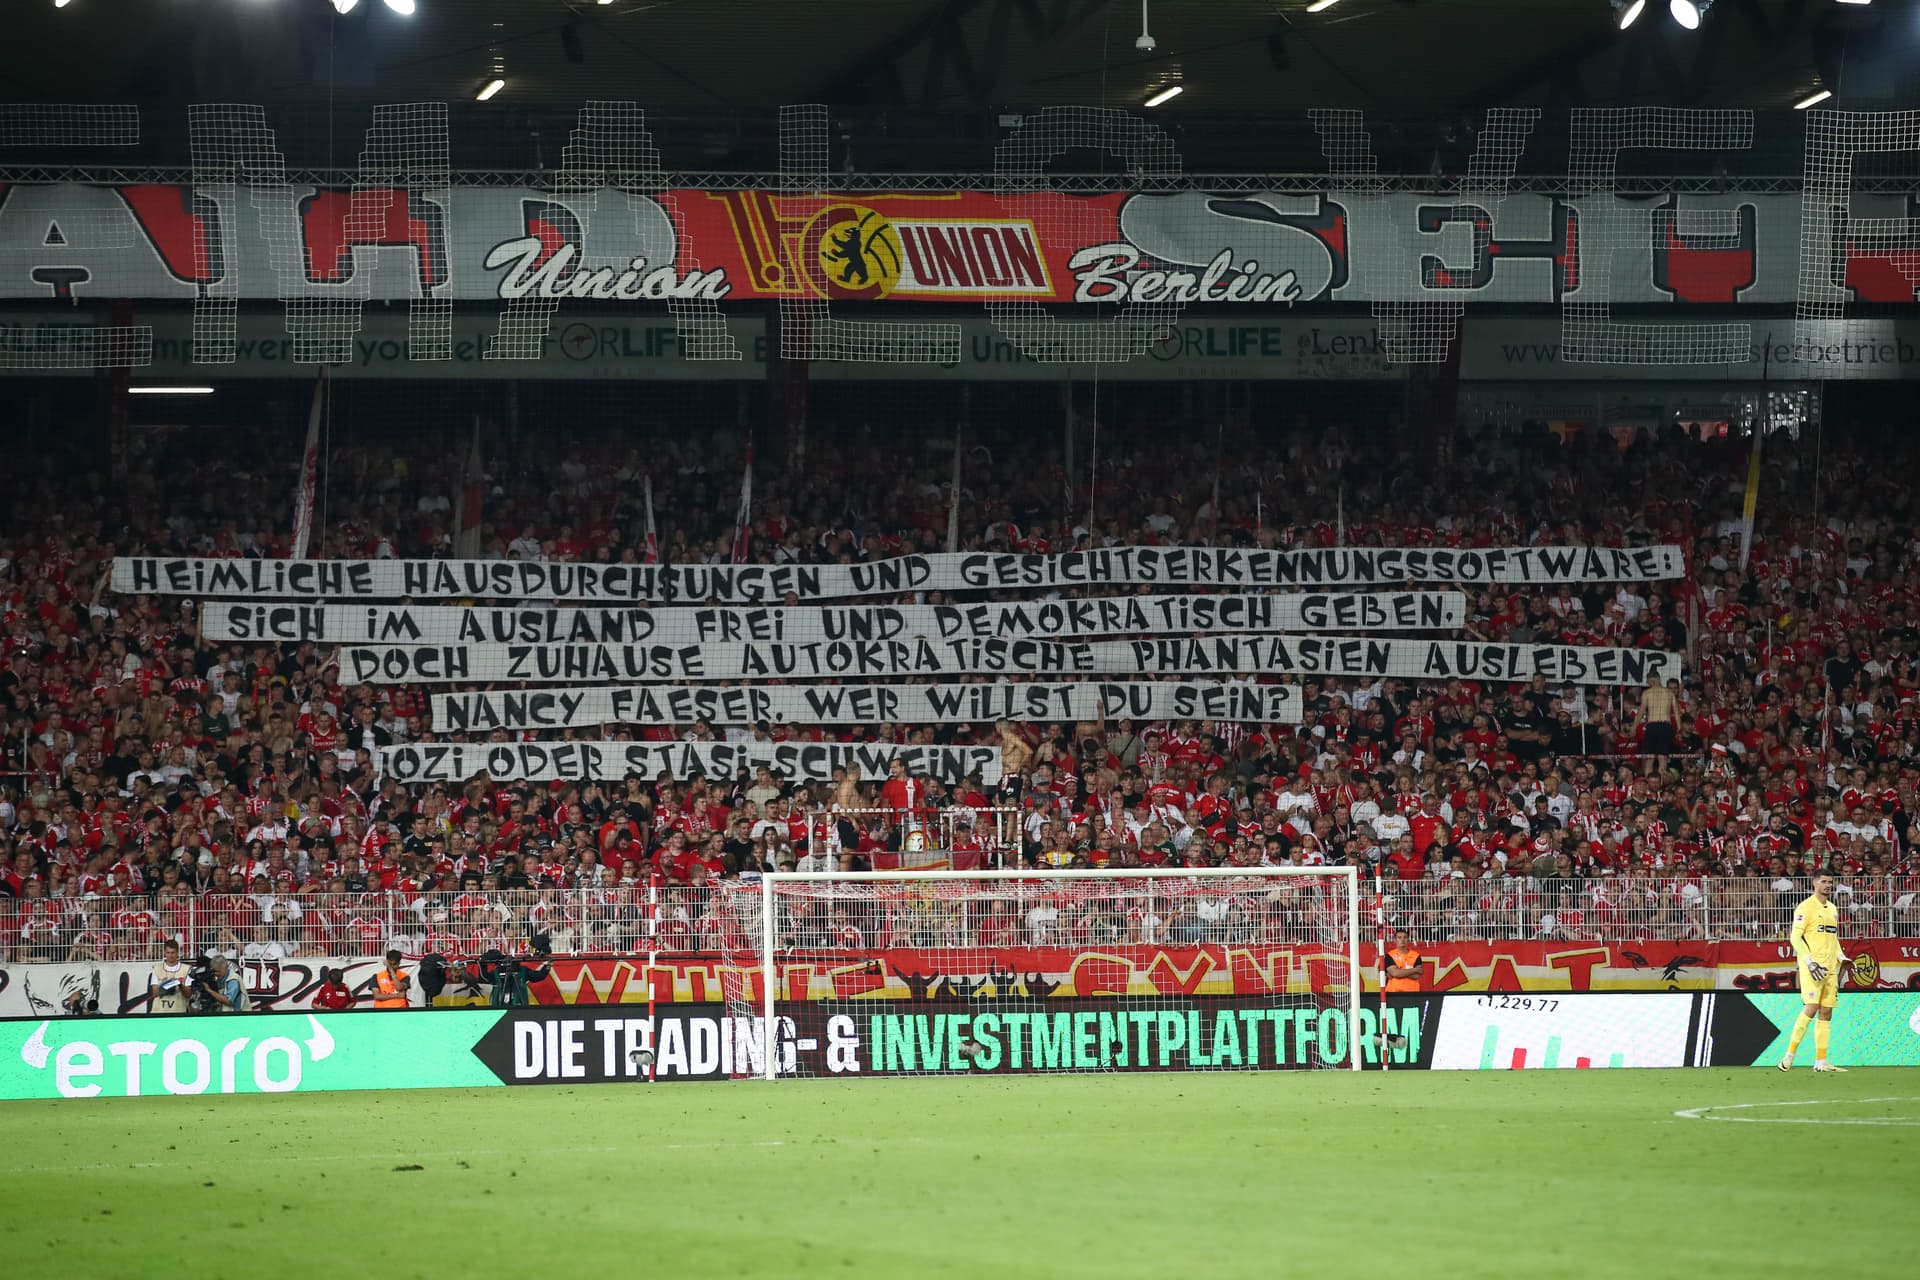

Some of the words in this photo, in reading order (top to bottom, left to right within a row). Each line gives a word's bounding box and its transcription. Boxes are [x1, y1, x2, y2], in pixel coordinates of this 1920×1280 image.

[484, 237, 731, 299] Union
[1068, 242, 1302, 300] Berlin
[902, 226, 1047, 288] UNION
[404, 562, 820, 599] HAUSDURCHSUNGEN
[850, 555, 931, 592] UND
[458, 607, 655, 643] AUSLAND
[822, 608, 904, 642] UND
[352, 646, 468, 681] DOCH
[508, 644, 704, 679] ZUHAUSE
[1424, 641, 1667, 684] AUSLEBEN?
[447, 691, 584, 730] NANCY
[805, 687, 898, 721] WER
[1100, 684, 1151, 716] DU
[489, 744, 602, 779] ODER
[160, 1000, 175, 1009] TV
[514, 1019, 586, 1079] DIE
[595, 1016, 818, 1078] TRADING-
[826, 1013, 860, 1073] &
[871, 1007, 1420, 1072] INVESTMENTPLATTFORM
